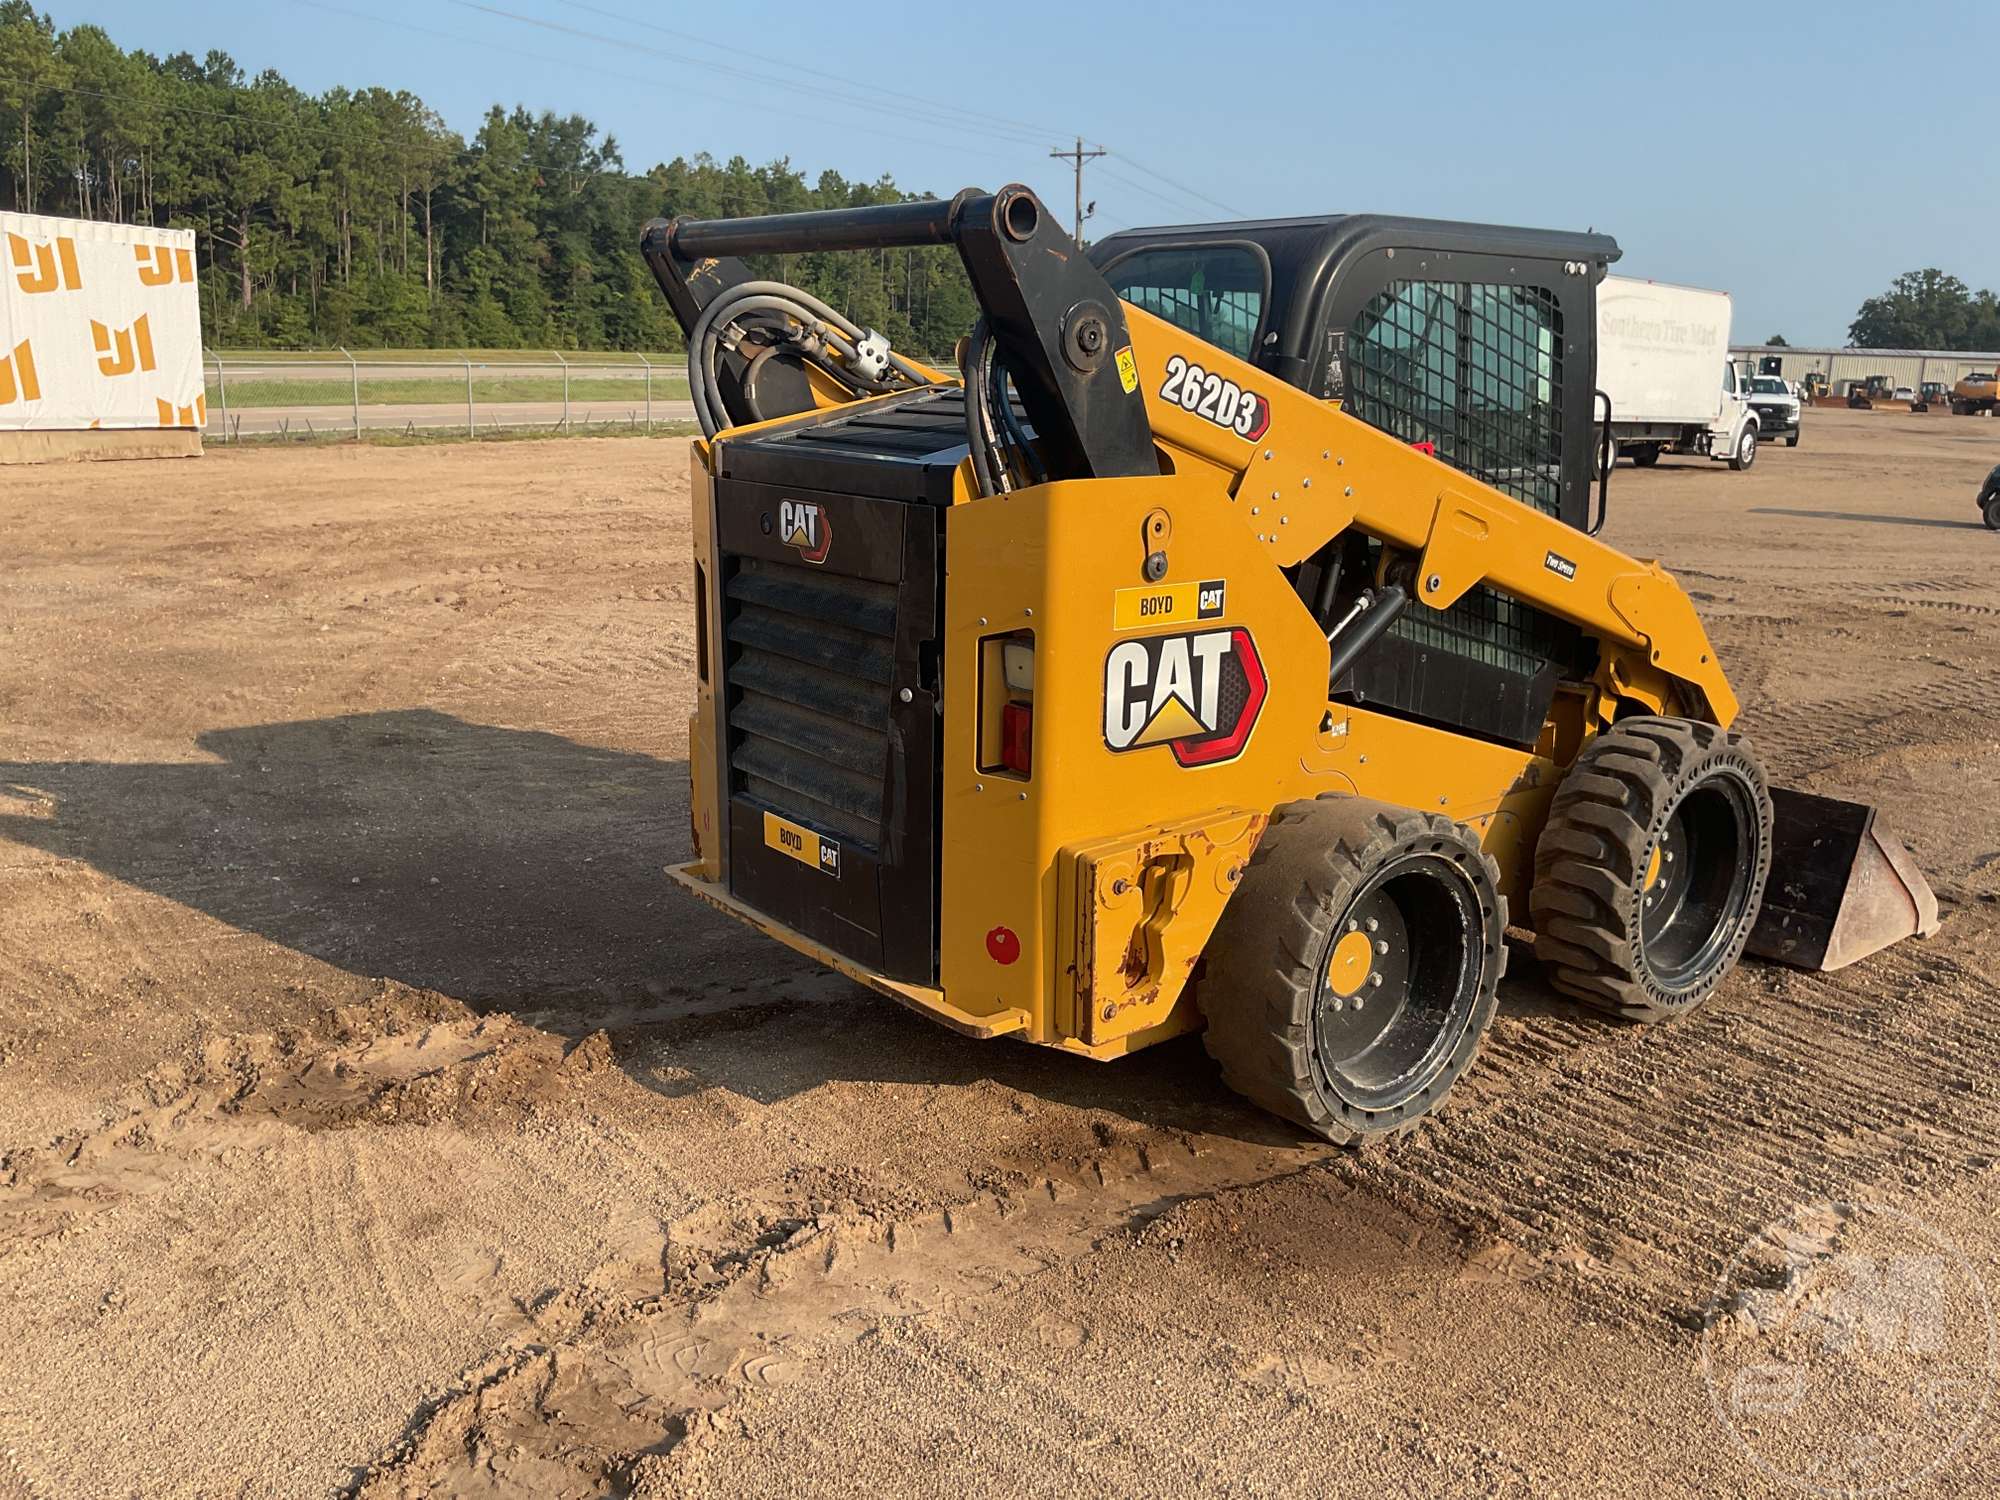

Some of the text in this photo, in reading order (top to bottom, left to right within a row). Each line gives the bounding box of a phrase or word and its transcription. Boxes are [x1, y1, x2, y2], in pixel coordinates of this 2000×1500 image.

[1160, 356, 1257, 435] 262D3
[781, 501, 818, 547] CAT
[1140, 589, 1224, 617] BOYD CAT
[1106, 631, 1232, 748] CAT
[780, 827, 837, 868] BOYD CAT
